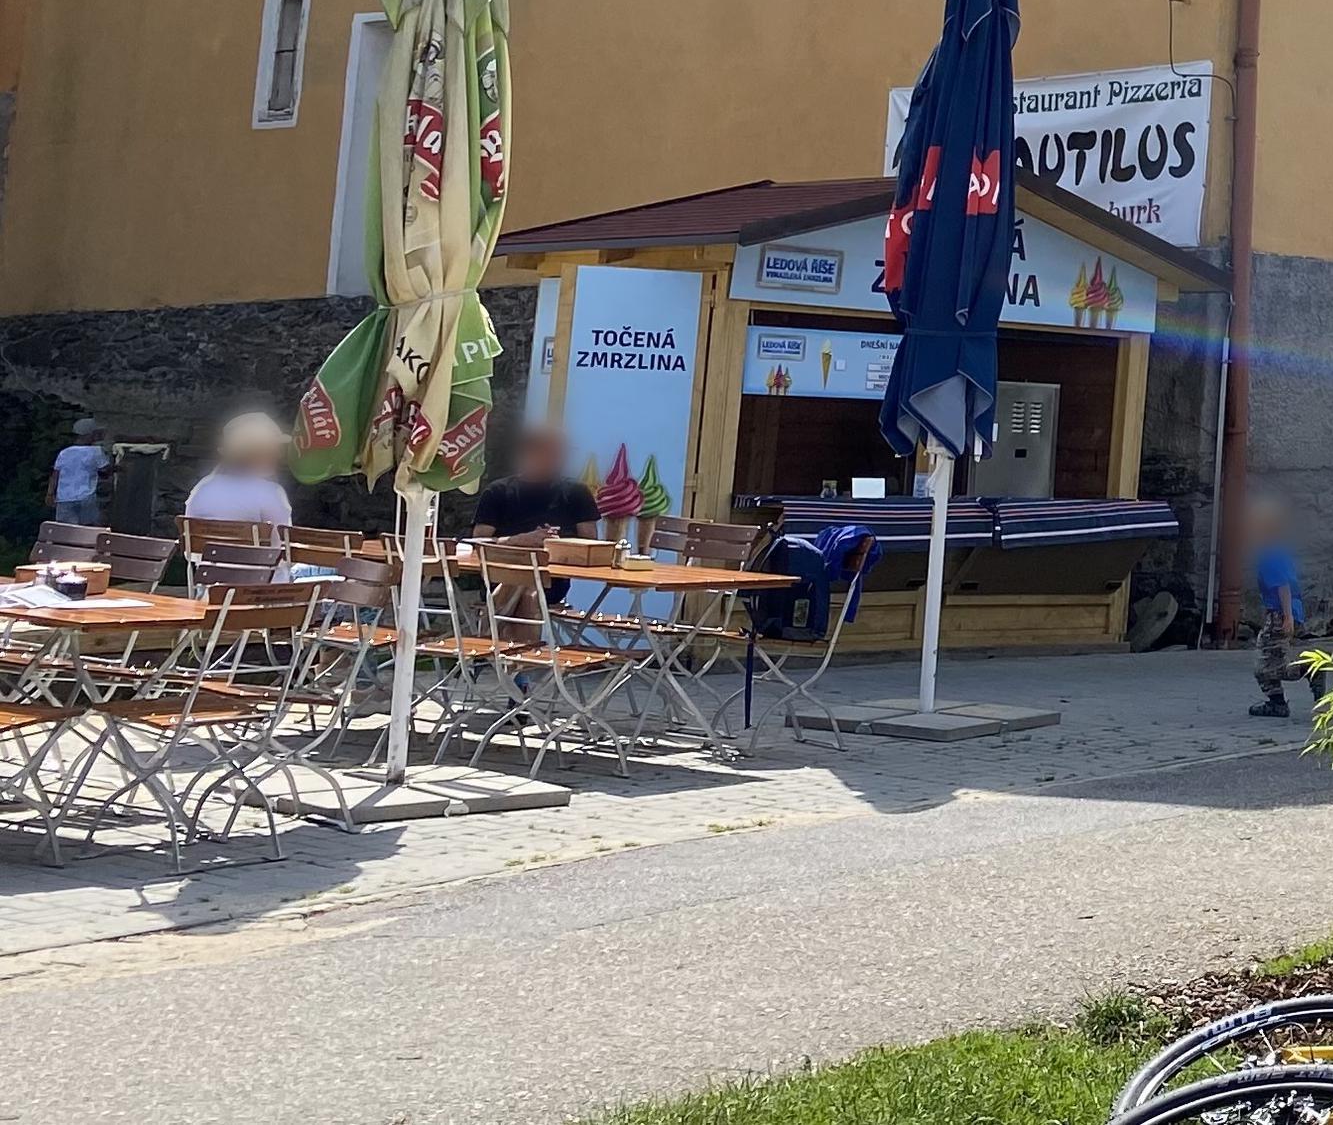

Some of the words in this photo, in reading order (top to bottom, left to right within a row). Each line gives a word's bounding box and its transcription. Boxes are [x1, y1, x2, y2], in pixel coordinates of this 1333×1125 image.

[1012, 83, 1100, 115] staurant
[1106, 77, 1202, 107] Pizzeria
[1014, 121, 1196, 187] AUTILUS
[766, 257, 808, 272] LEDOVÁ
[591, 325, 676, 349] TOČENÁ
[576, 350, 686, 372] ZMRZLINA
